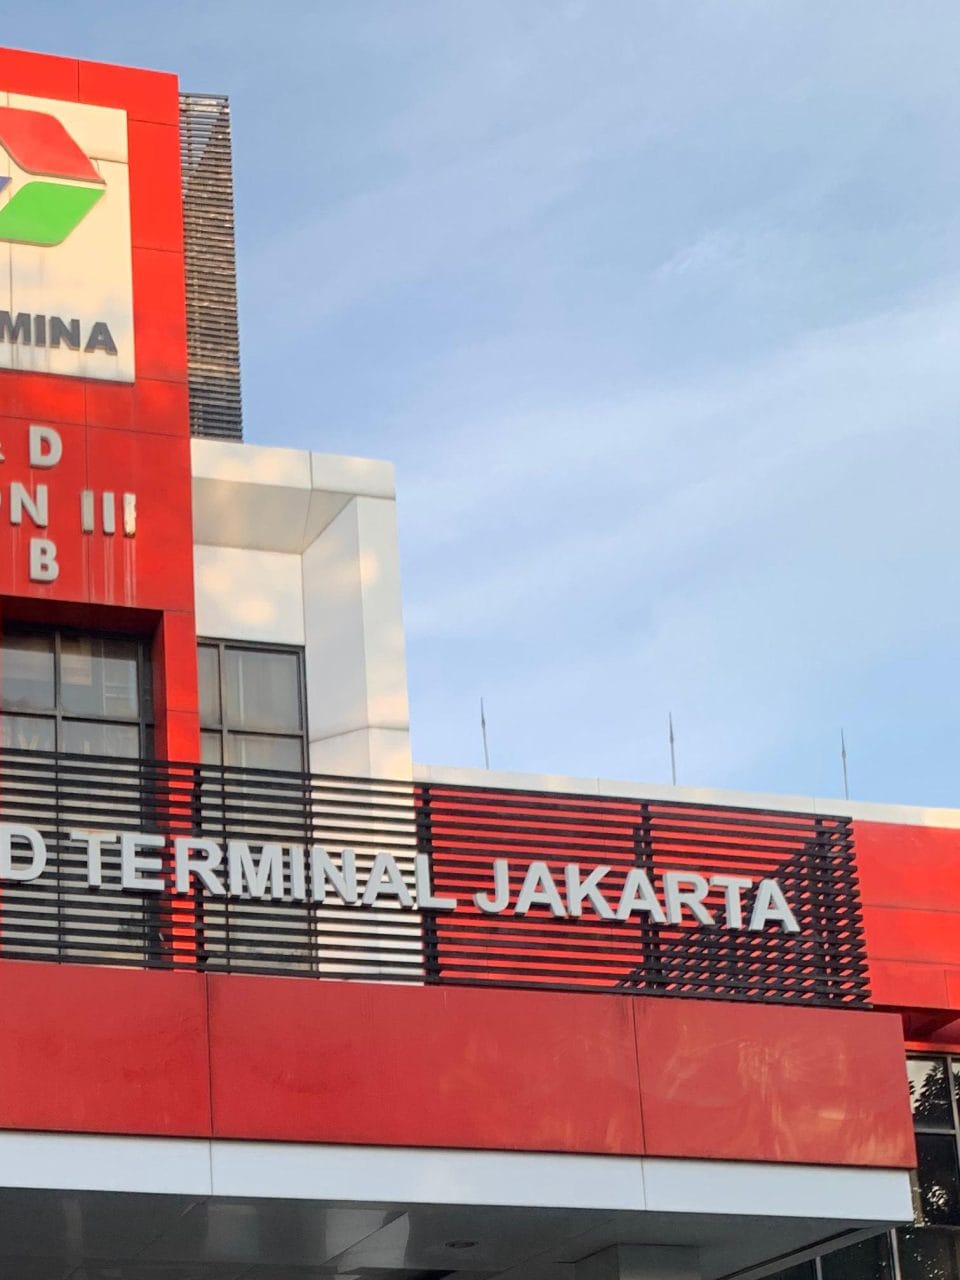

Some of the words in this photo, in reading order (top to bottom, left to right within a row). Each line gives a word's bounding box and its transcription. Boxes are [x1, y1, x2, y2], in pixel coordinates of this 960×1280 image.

[29, 424, 62, 469] D
[80, 489, 136, 538] III
[30, 537, 59, 583] B
[69, 830, 457, 912] TERMINAL
[472, 859, 801, 934] JAKARTA
